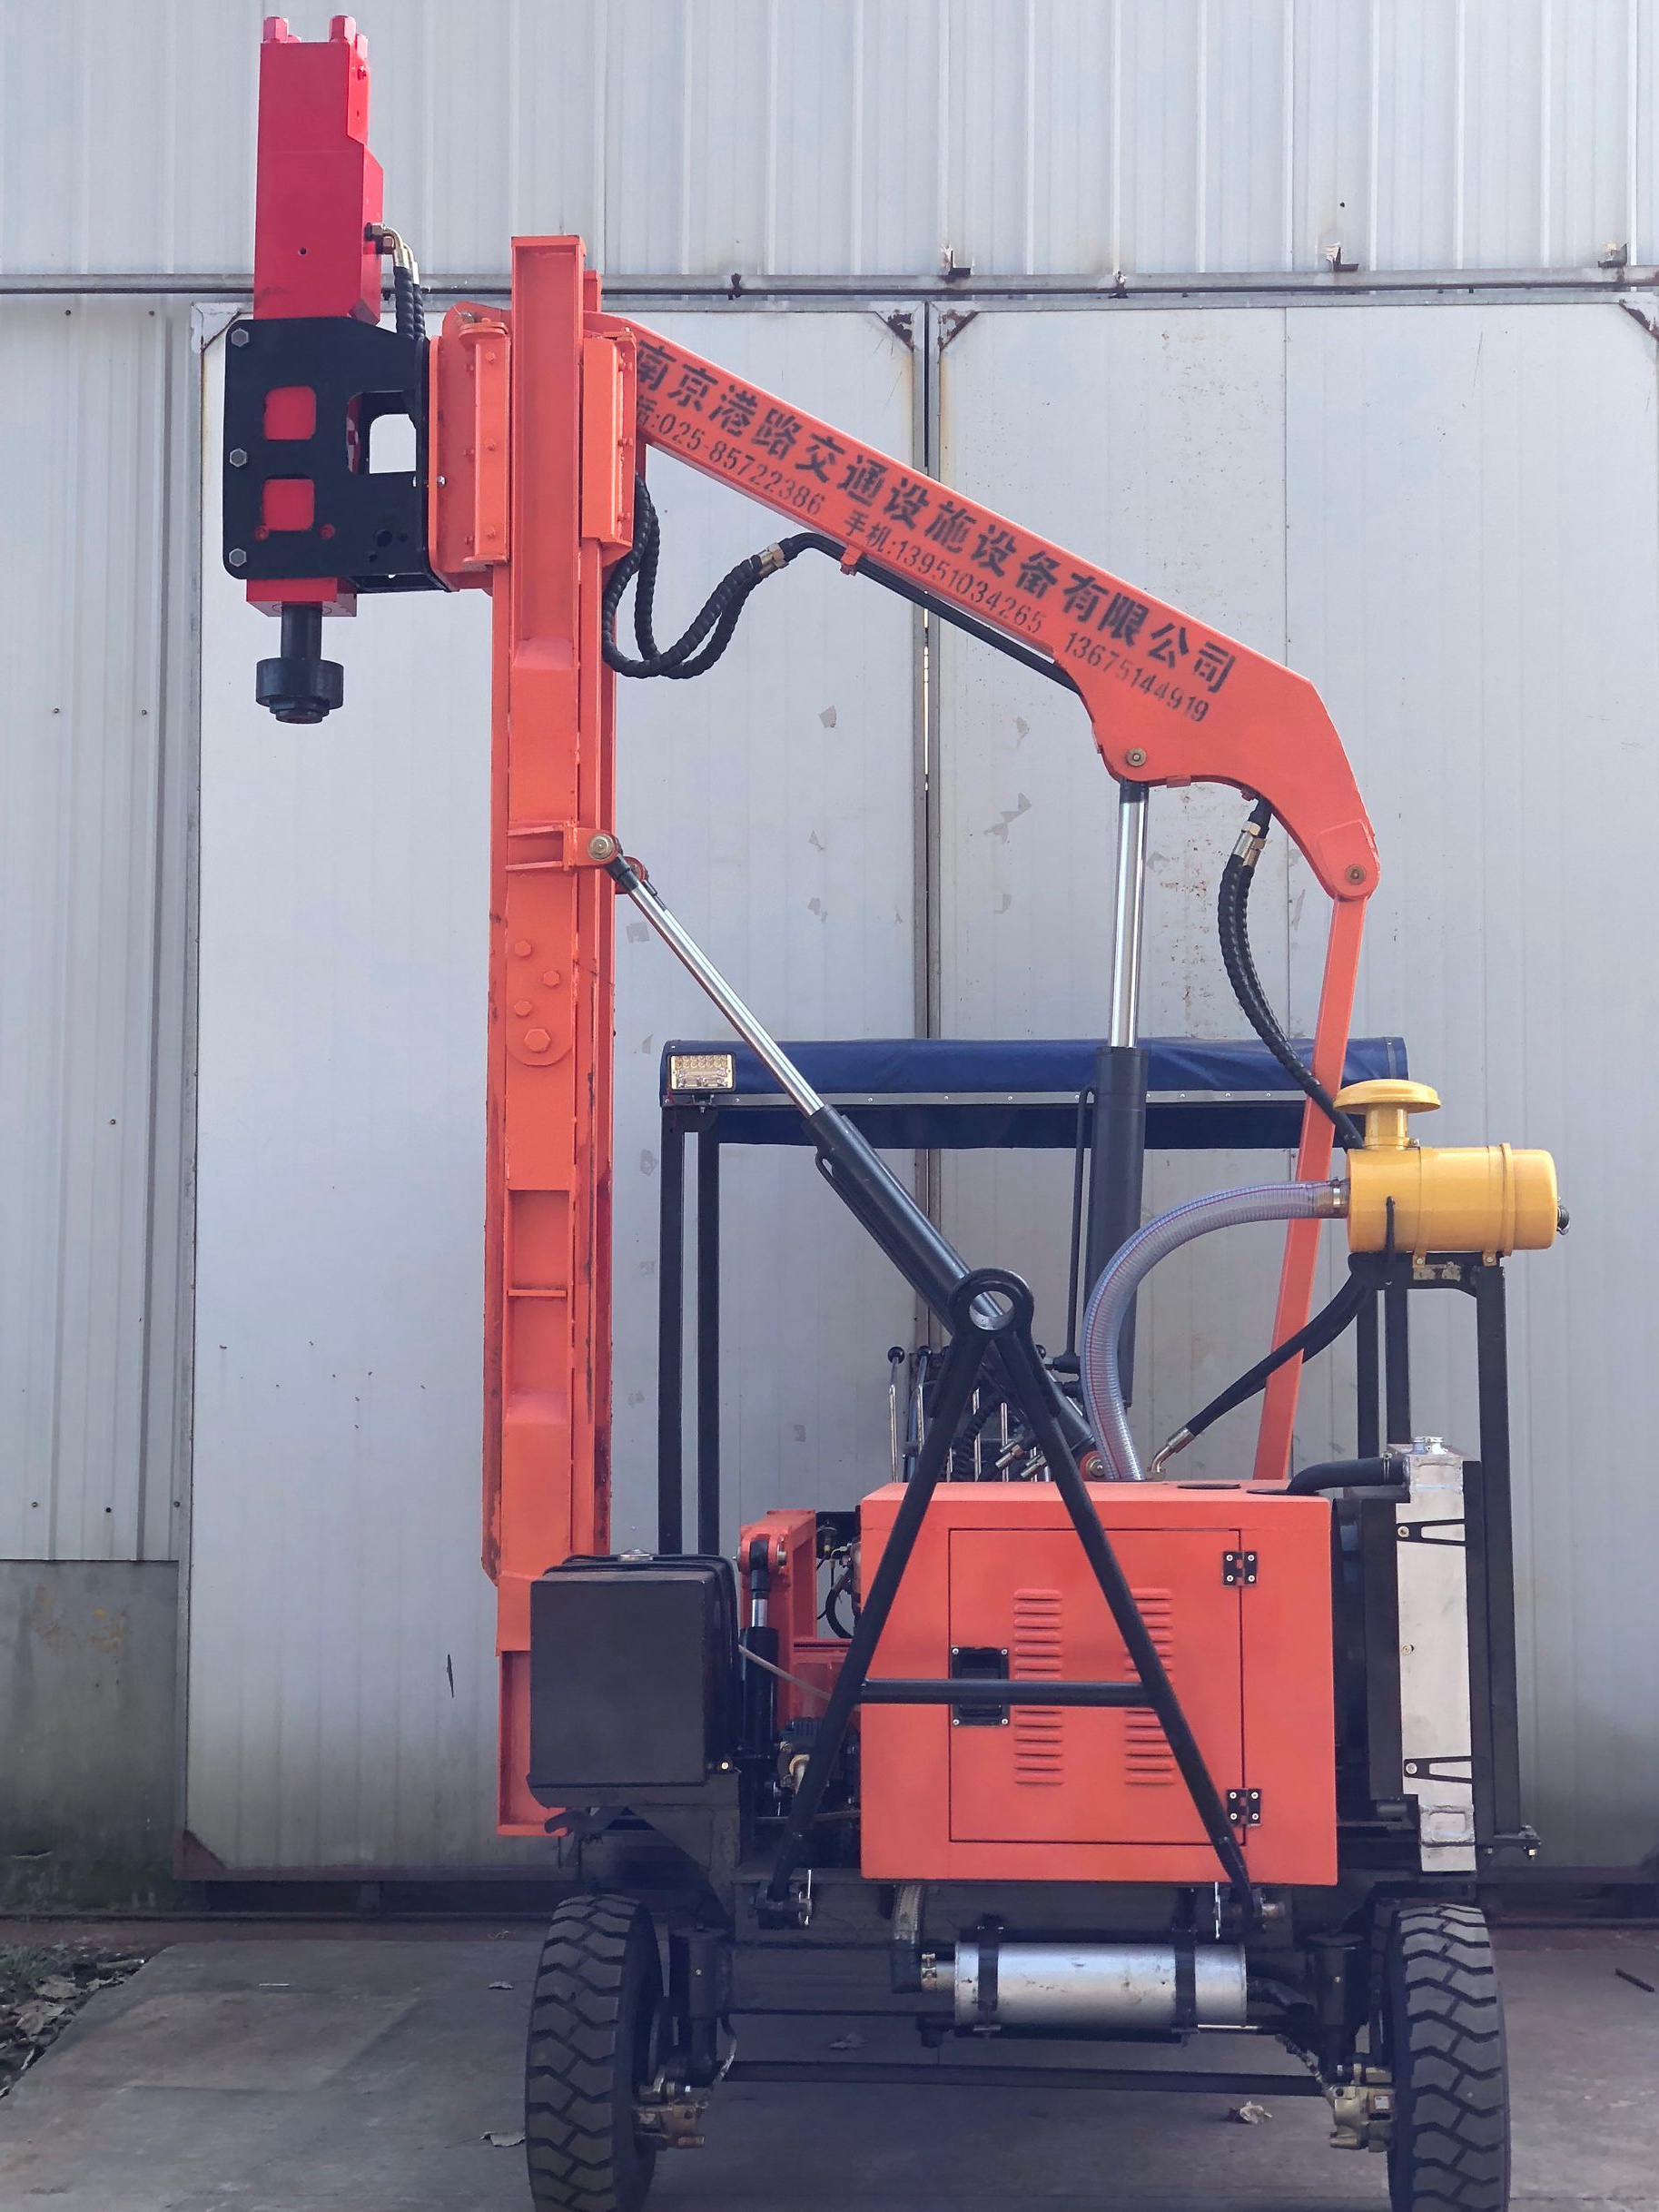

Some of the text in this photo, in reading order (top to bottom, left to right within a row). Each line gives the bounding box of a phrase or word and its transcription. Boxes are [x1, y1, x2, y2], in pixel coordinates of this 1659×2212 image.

[637, 340, 1236, 693] 南京港路交通设施设备有限公司
[844, 509, 1047, 634] 手机:13951034265
[1064, 632, 1210, 722] 13675144919
